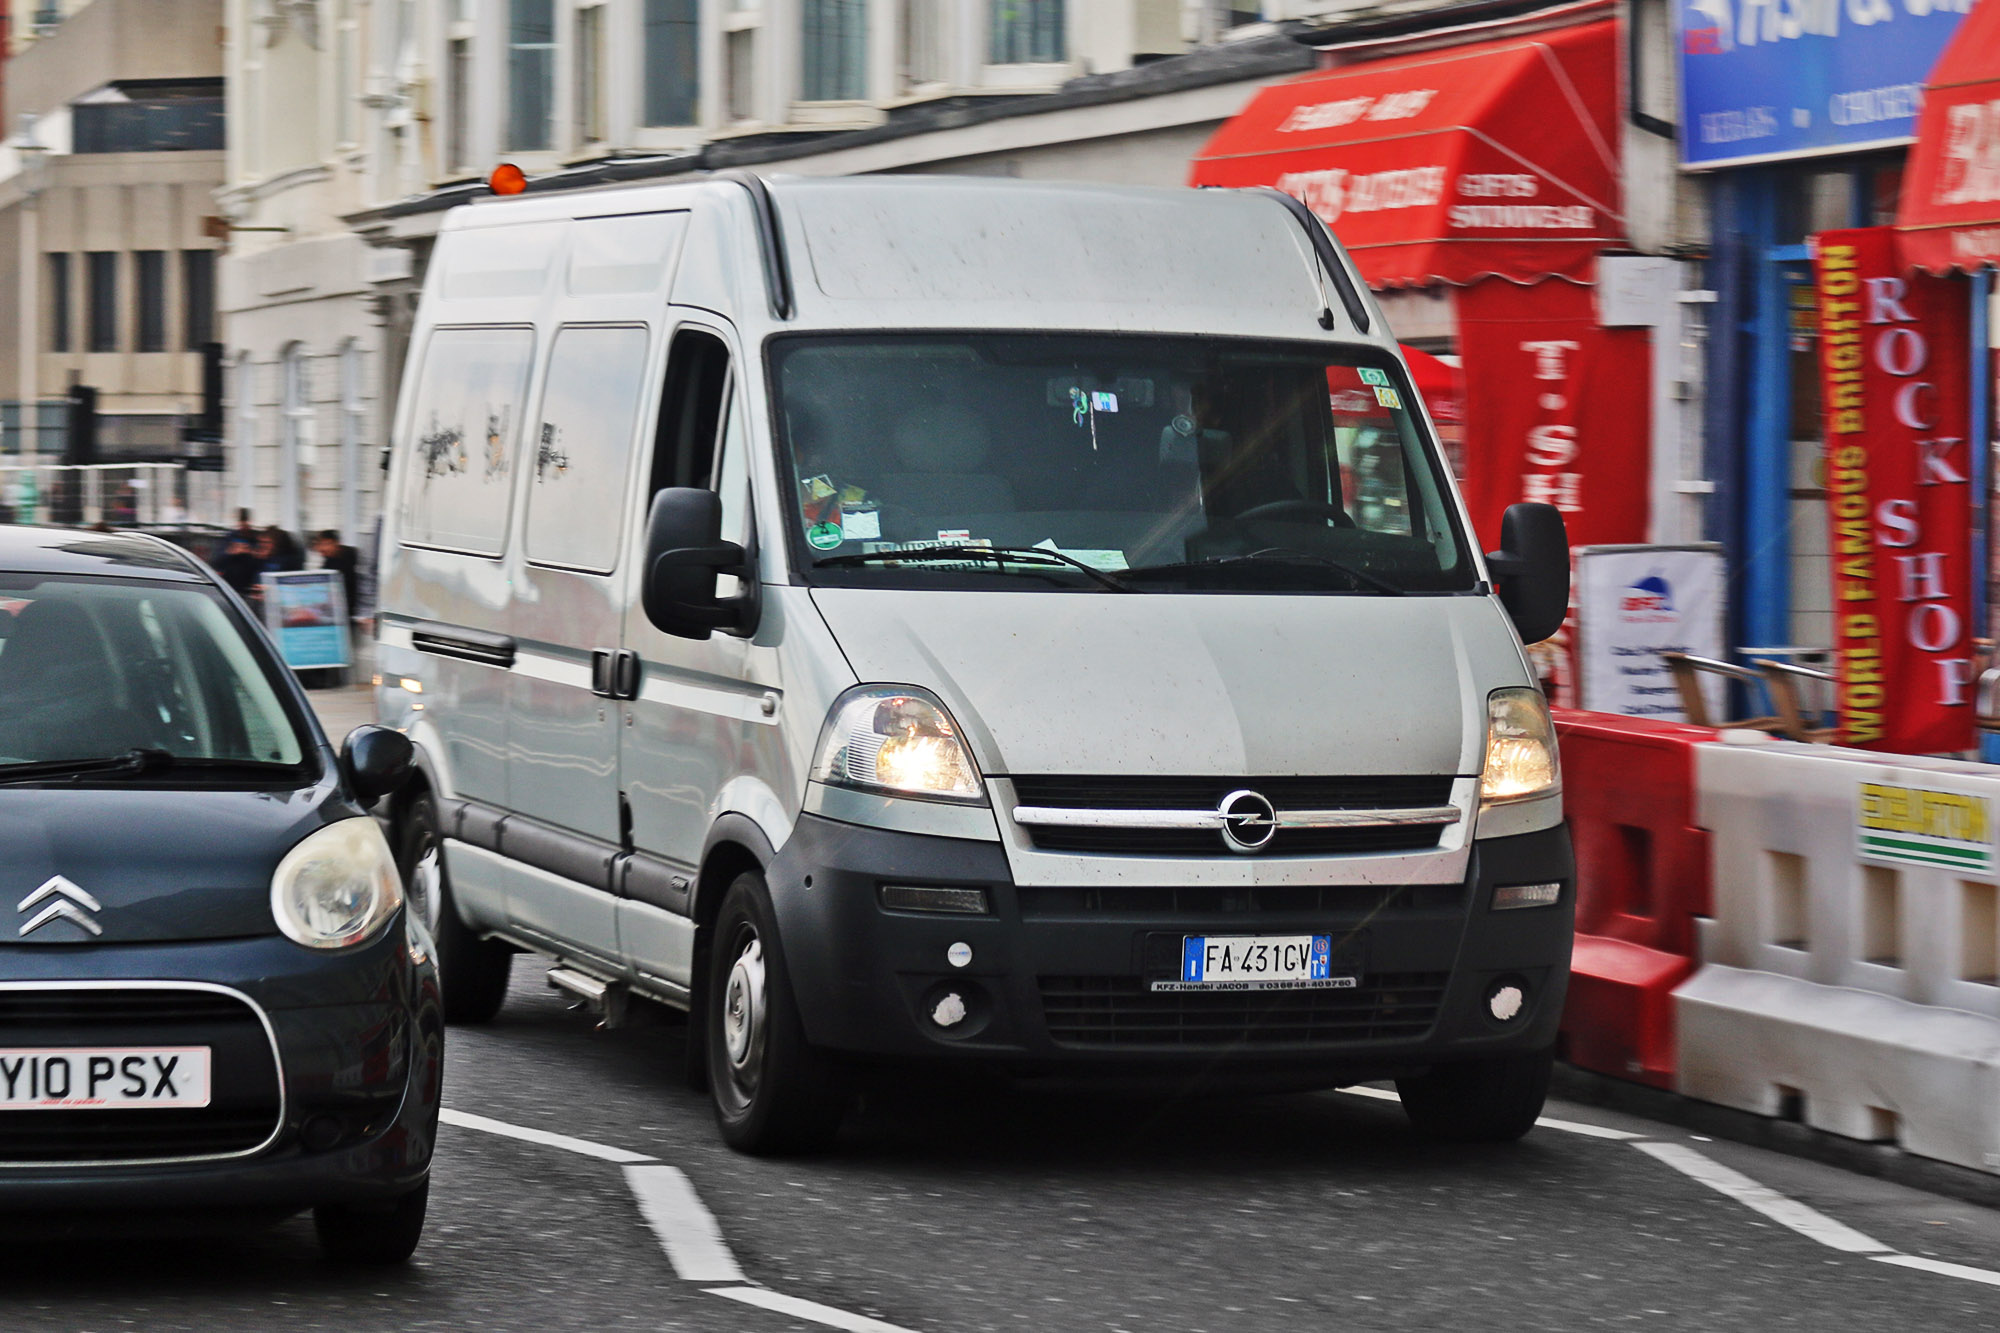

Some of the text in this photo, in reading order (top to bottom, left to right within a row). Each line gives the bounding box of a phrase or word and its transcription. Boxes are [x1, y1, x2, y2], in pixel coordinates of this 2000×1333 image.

[1457, 174, 1539, 197] GIFTS
[1862, 277, 1969, 486] ROCK
[1819, 245, 1887, 743] WORLD FAMOUS BRIGHTON
[1874, 499, 1976, 706] SHOP
[1205, 943, 1311, 973] FA 431GV
[1156, 982, 1214, 991] KFZ-Handel
[1216, 981, 1250, 991] JACOB
[88, 1055, 179, 1099] PSX
